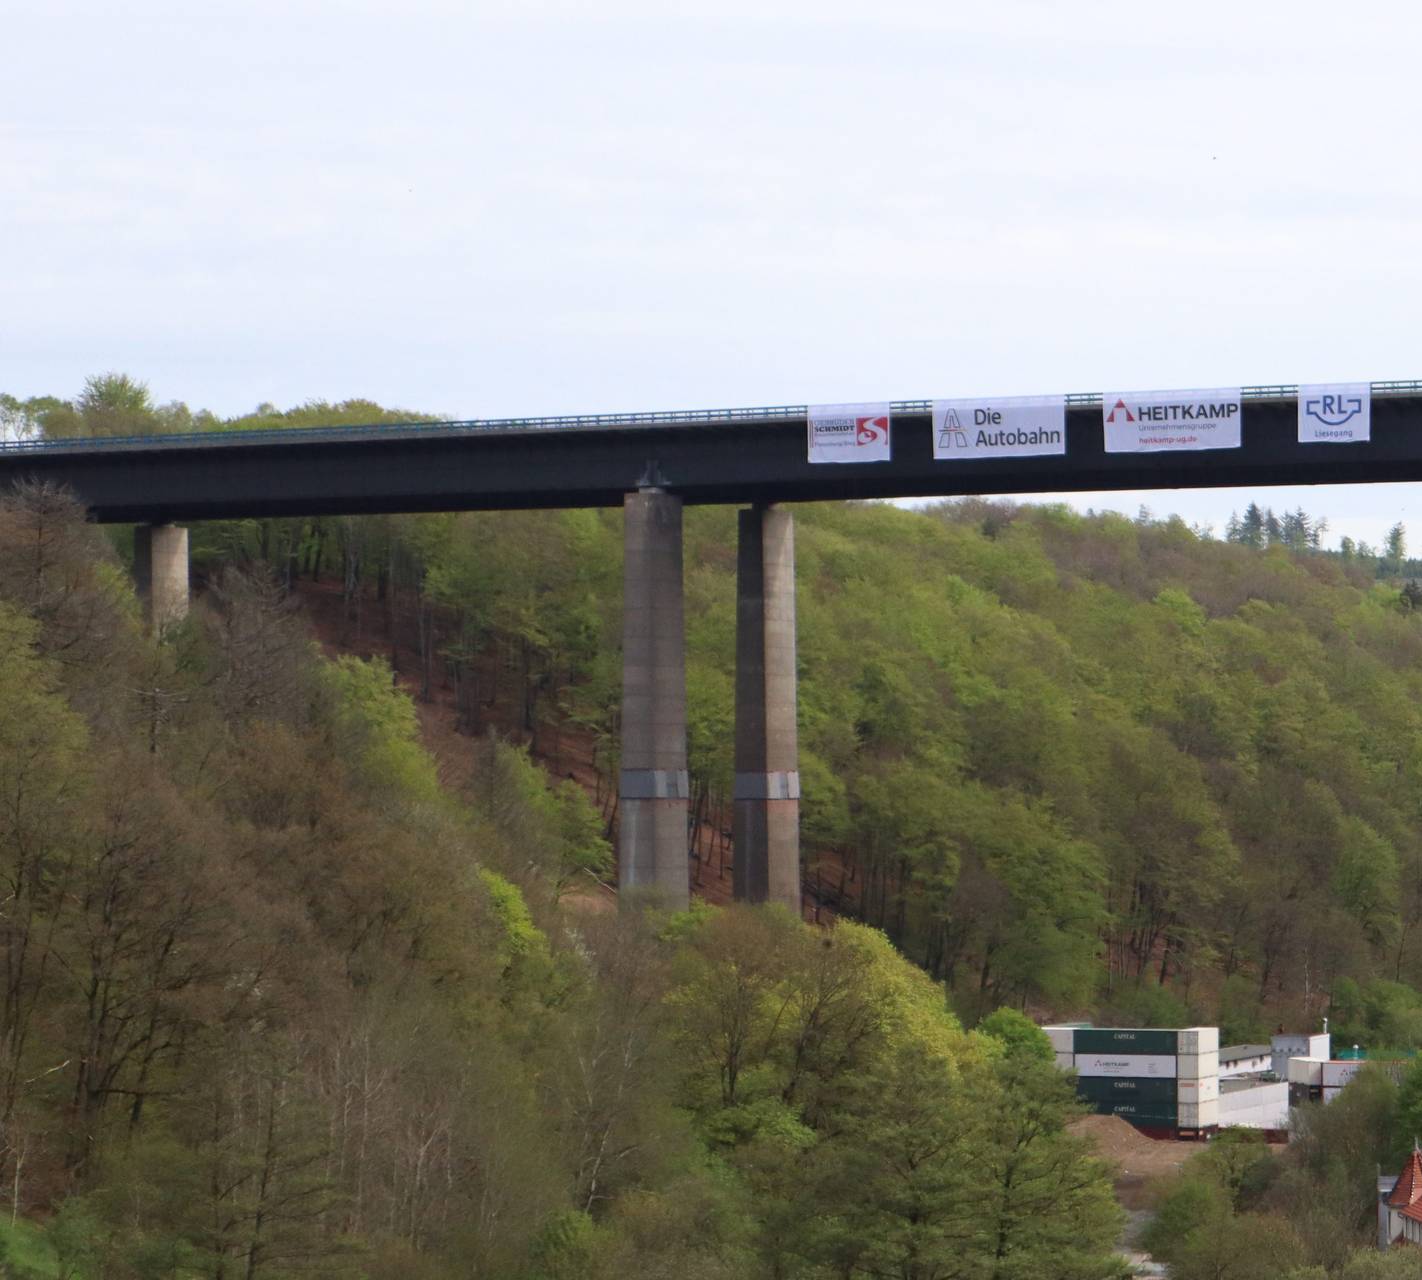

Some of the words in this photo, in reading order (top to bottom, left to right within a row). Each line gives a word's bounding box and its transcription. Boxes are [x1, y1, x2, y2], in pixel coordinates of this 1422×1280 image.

[1138, 403, 1238, 421] HEITKAMP
[1322, 395, 1348, 415] RL
[974, 407, 1002, 425] Die
[814, 425, 855, 433] SCHMIDT
[975, 426, 1061, 447] Autobahn
[1314, 429, 1353, 438] Liesegang
